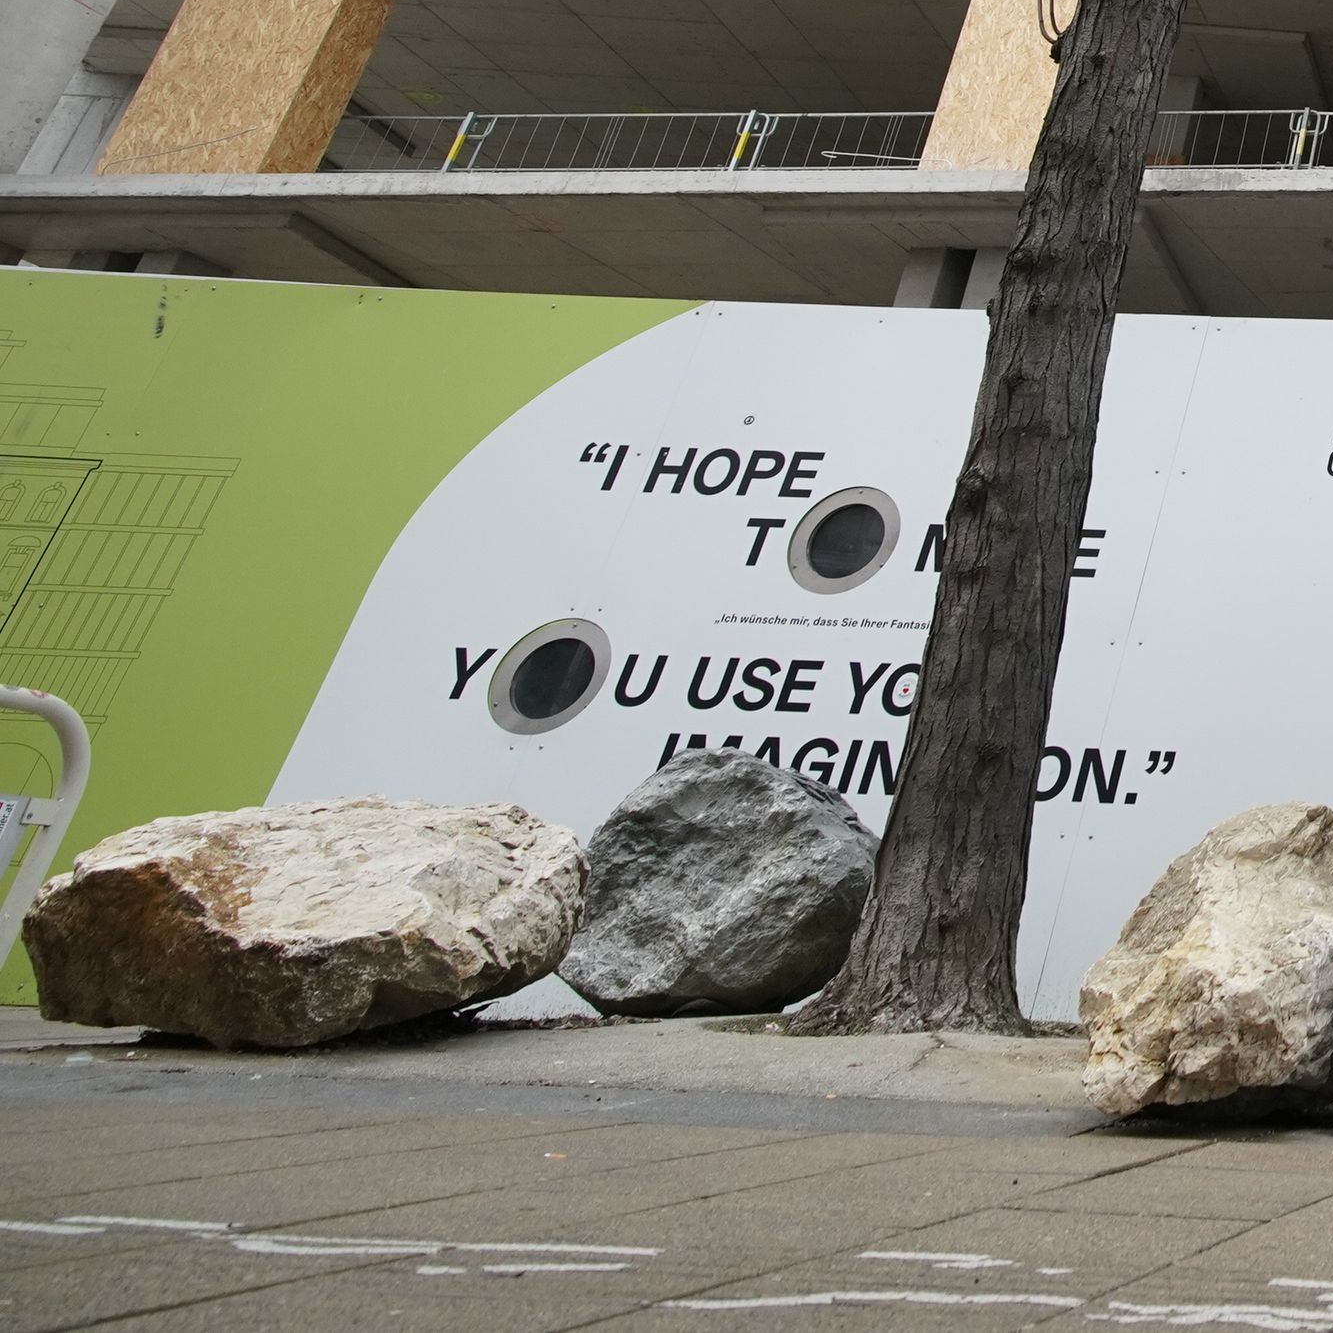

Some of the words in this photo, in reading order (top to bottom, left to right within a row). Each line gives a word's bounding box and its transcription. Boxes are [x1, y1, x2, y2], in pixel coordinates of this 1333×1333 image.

[643, 447, 825, 498] HOPE
[740, 614, 788, 625] wünsche
[790, 616, 810, 627] mir,
[813, 616, 838, 627] dass
[841, 617, 858, 628] Sie
[860, 618, 888, 629] Ihrer
[890, 619, 931, 631] Fantasi
[687, 656, 824, 713] USE
